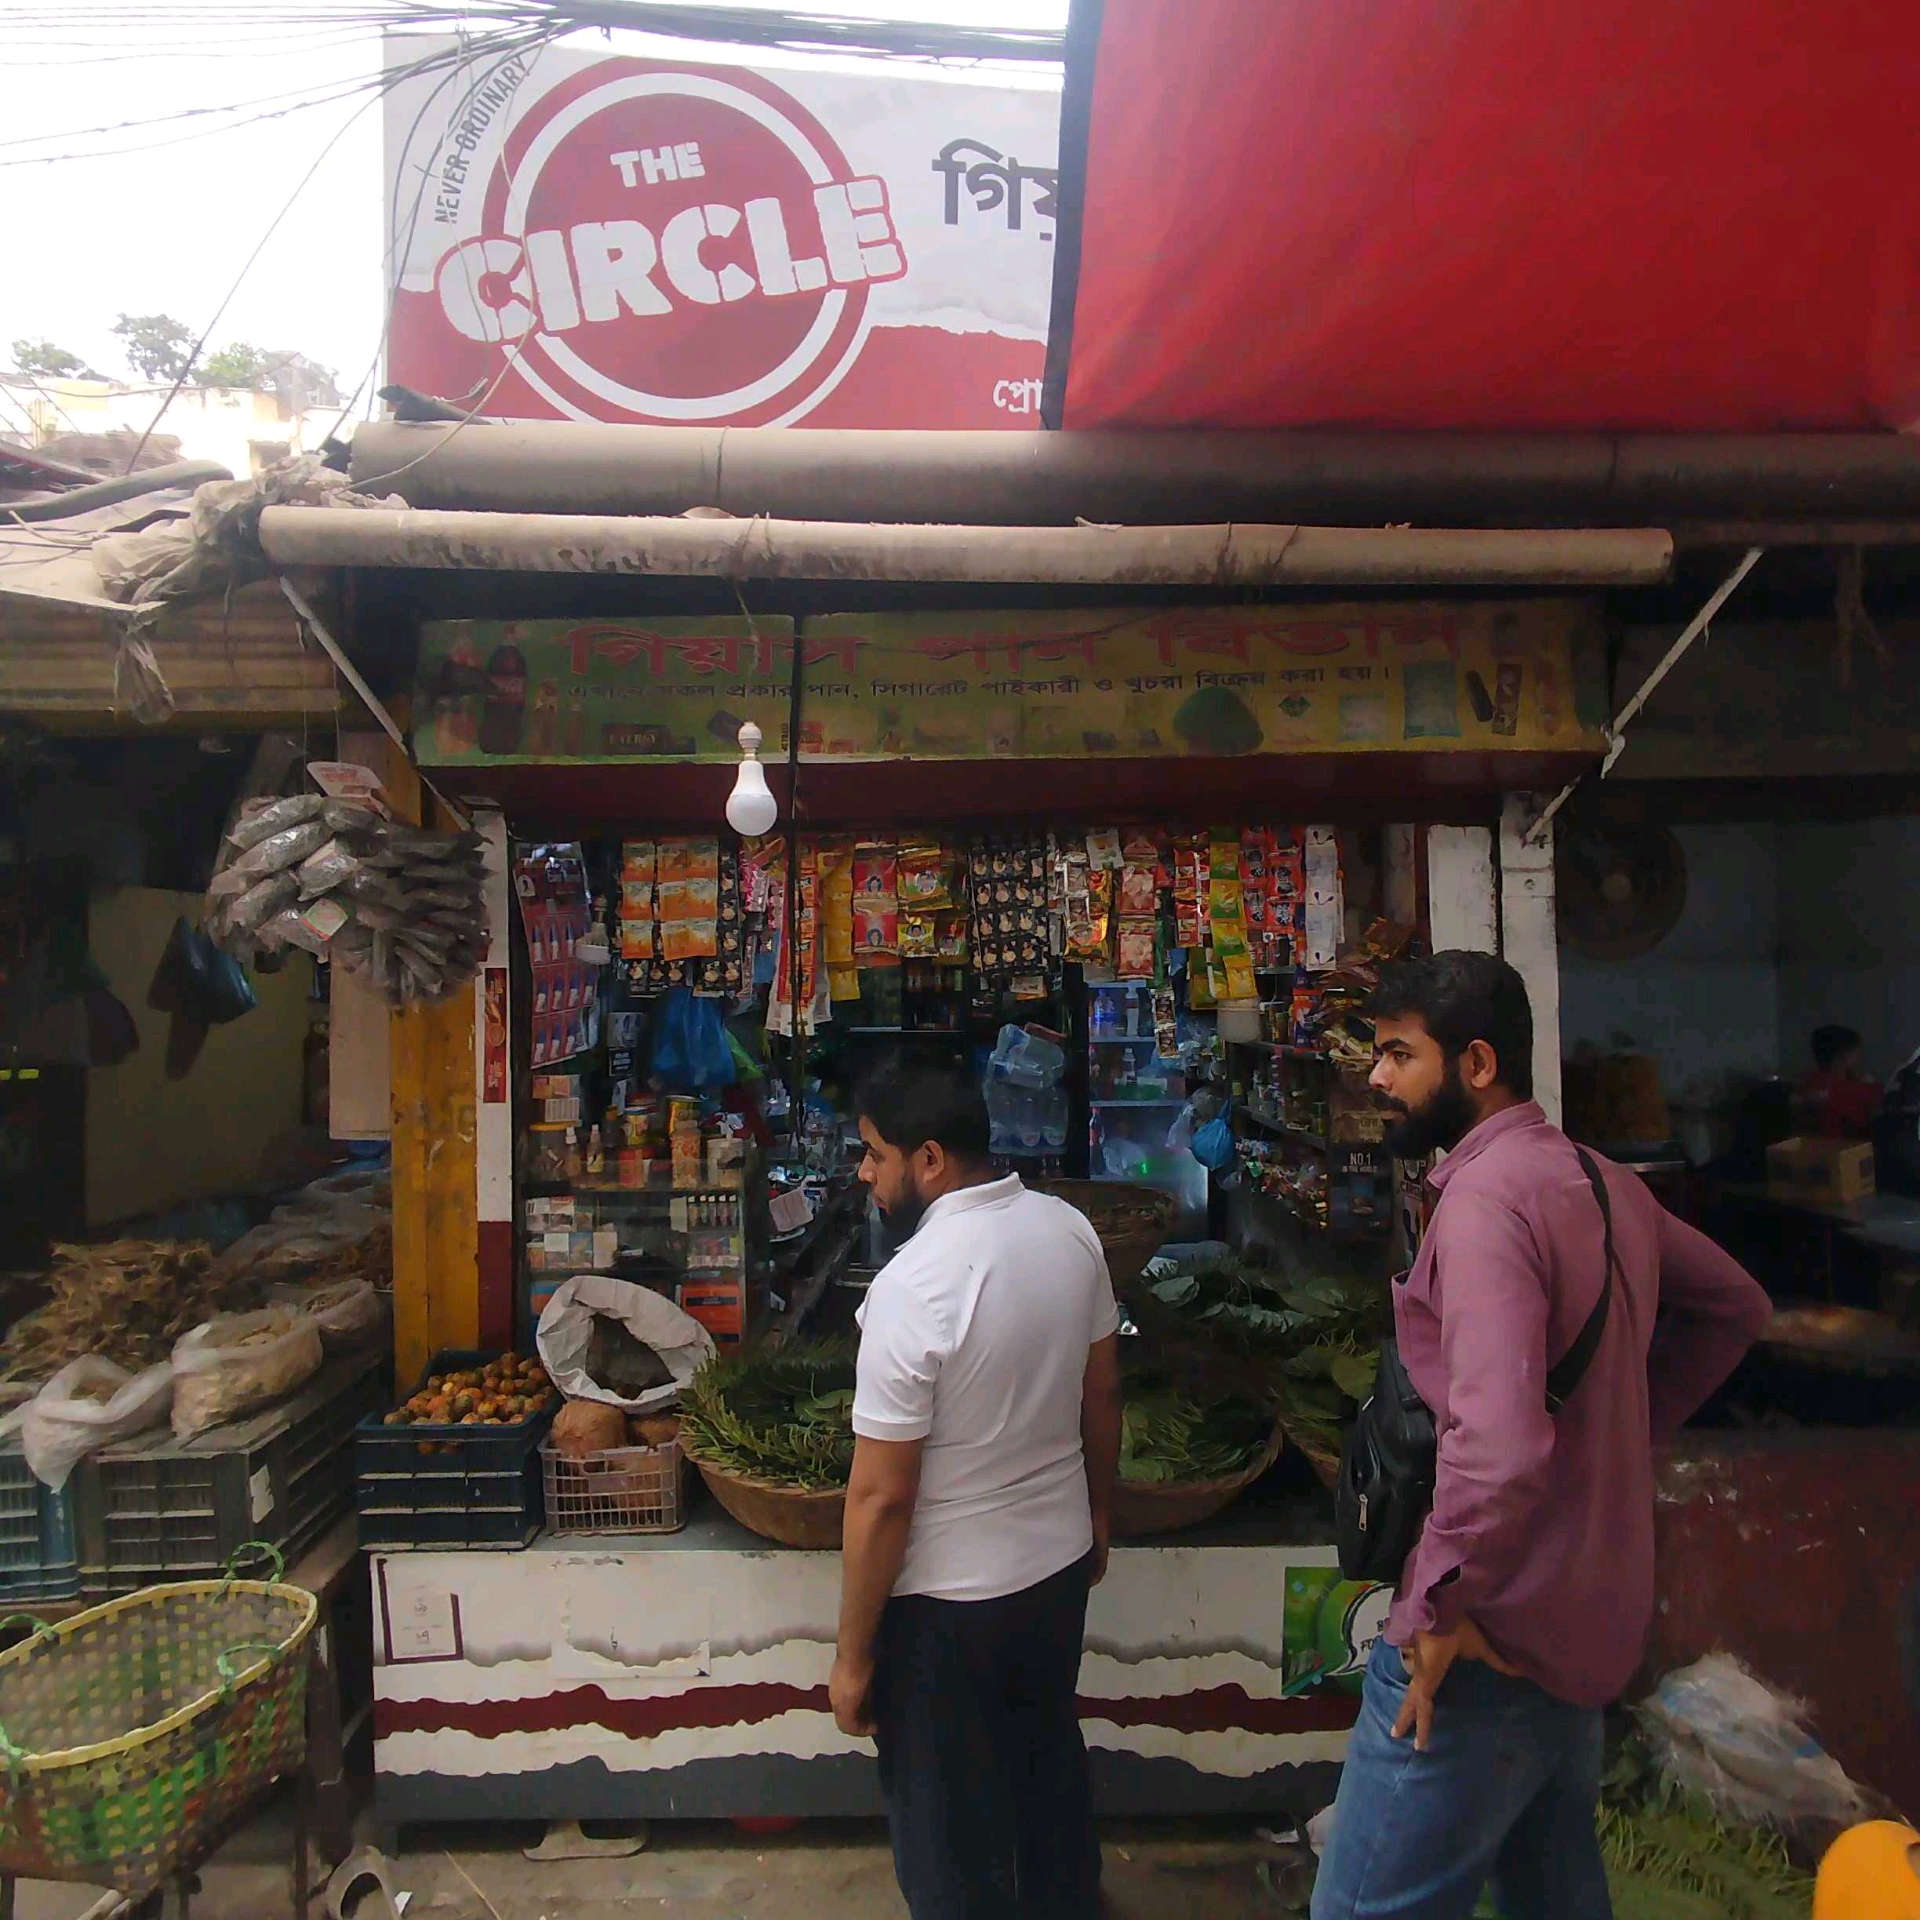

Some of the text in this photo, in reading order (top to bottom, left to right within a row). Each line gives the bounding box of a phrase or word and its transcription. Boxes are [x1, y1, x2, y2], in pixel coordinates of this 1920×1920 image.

[434, 55, 528, 225] NEVER ORDINARY
[609, 142, 706, 188] THE
[438, 179, 906, 344] CIRCLE
[726, 683, 792, 698] প্রকার
[807, 684, 859, 700] পান,
[871, 679, 968, 698] সিগারেট
[1096, 677, 1113, 691] ও
[1124, 674, 1183, 694] খুচরা
[1280, 666, 1325, 683] করা
